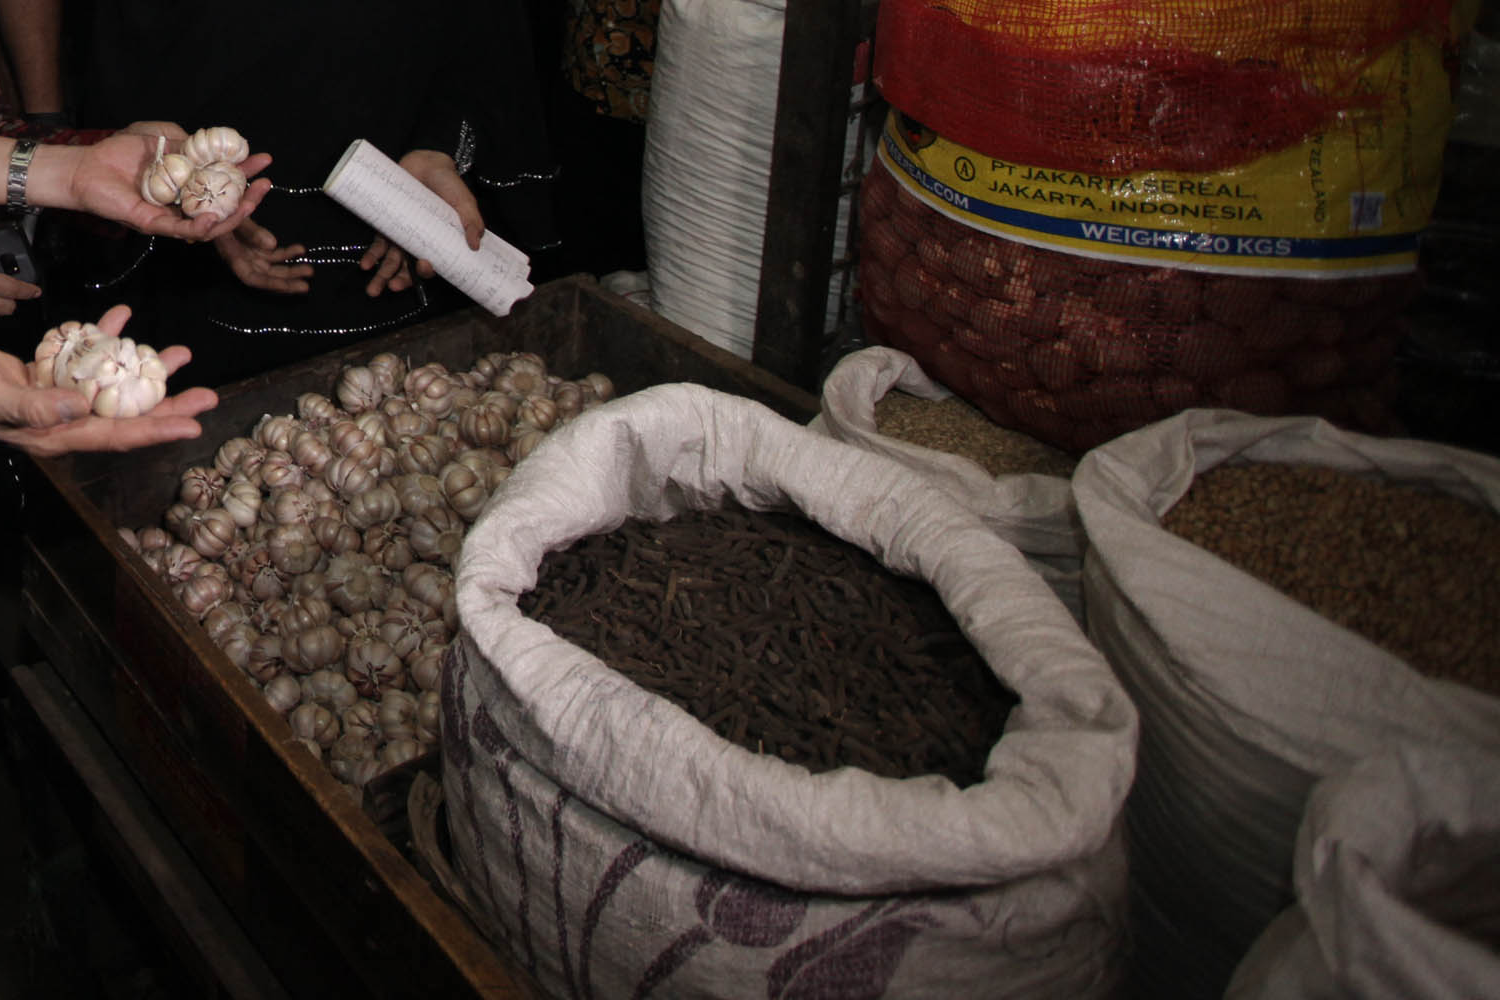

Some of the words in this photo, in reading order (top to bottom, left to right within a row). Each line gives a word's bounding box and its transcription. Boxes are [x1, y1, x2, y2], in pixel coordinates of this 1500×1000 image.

[991, 159, 1014, 176] PT
[1021, 166, 1136, 193] JAKARTA
[1111, 196, 1264, 221] INDONESIA
[1079, 221, 1187, 249] WEIGHT
[1236, 238, 1291, 256] KGS
